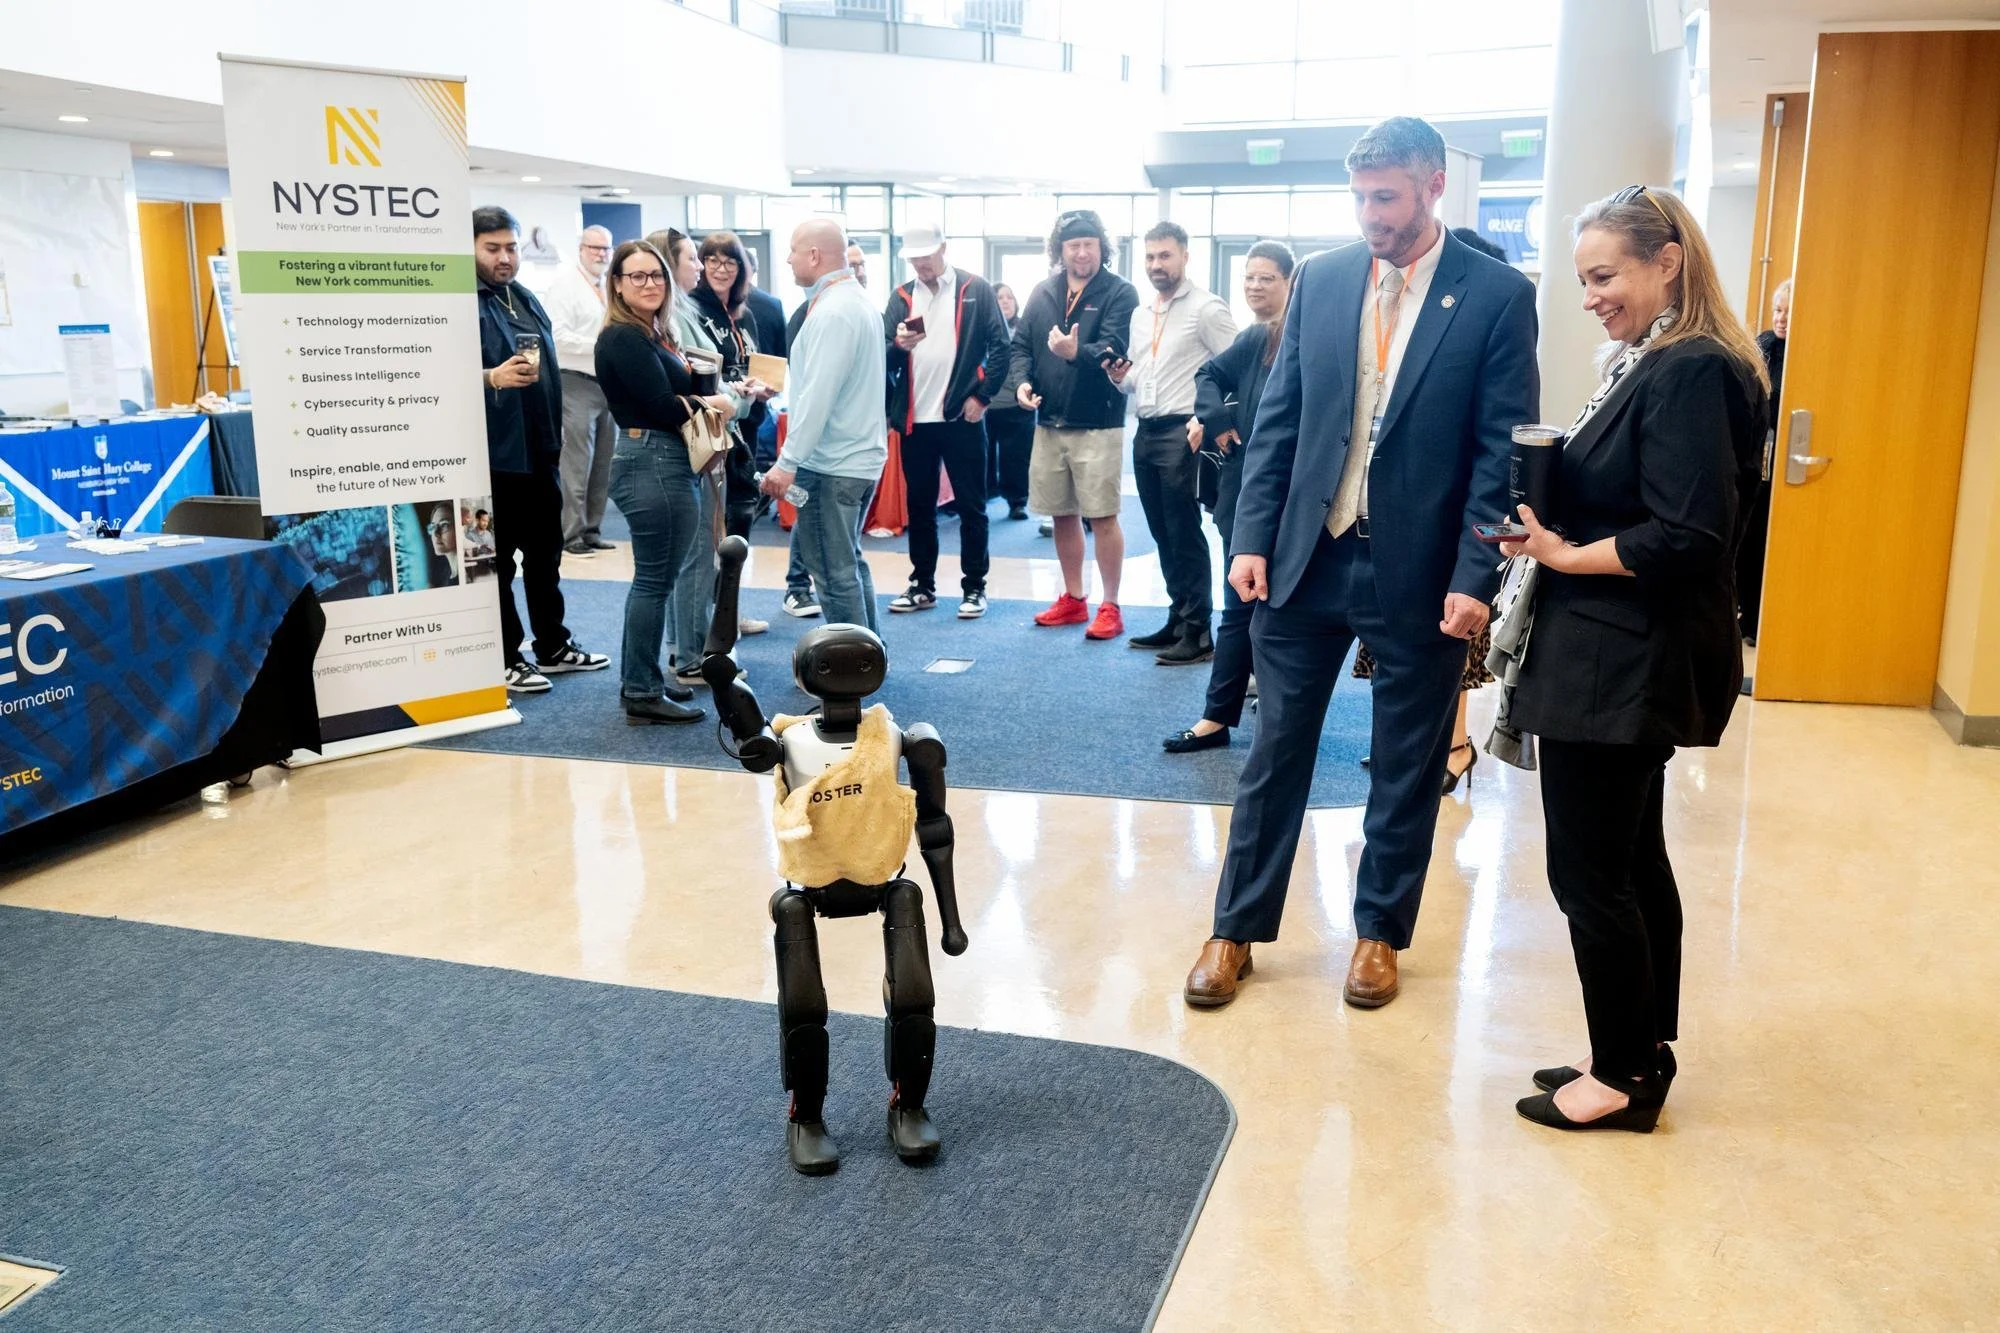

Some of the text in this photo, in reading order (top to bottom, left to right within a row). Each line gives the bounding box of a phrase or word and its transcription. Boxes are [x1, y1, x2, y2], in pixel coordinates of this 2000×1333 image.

[273, 181, 440, 219] NYSTEC
[276, 222, 443, 235] New York's Partner in Transformation
[279, 260, 446, 273] Fostering a vibrant future for
[296, 275, 434, 288] New York communities.
[297, 315, 448, 329] Technology modernization
[299, 344, 432, 356] Service Transformation
[302, 370, 421, 383] Business Intelligence
[304, 395, 440, 412] Cybersecurity & privacy
[306, 423, 410, 438] Quality assurance
[51, 467, 80, 480] Mount
[123, 460, 152, 474] College
[290, 456, 467, 480] Inspire, enable, and empower
[316, 474, 445, 494] the future of New York
[344, 621, 442, 645] Partner With Us
[444, 640, 495, 656] nystec.com
[809, 783, 862, 804] OSTER
